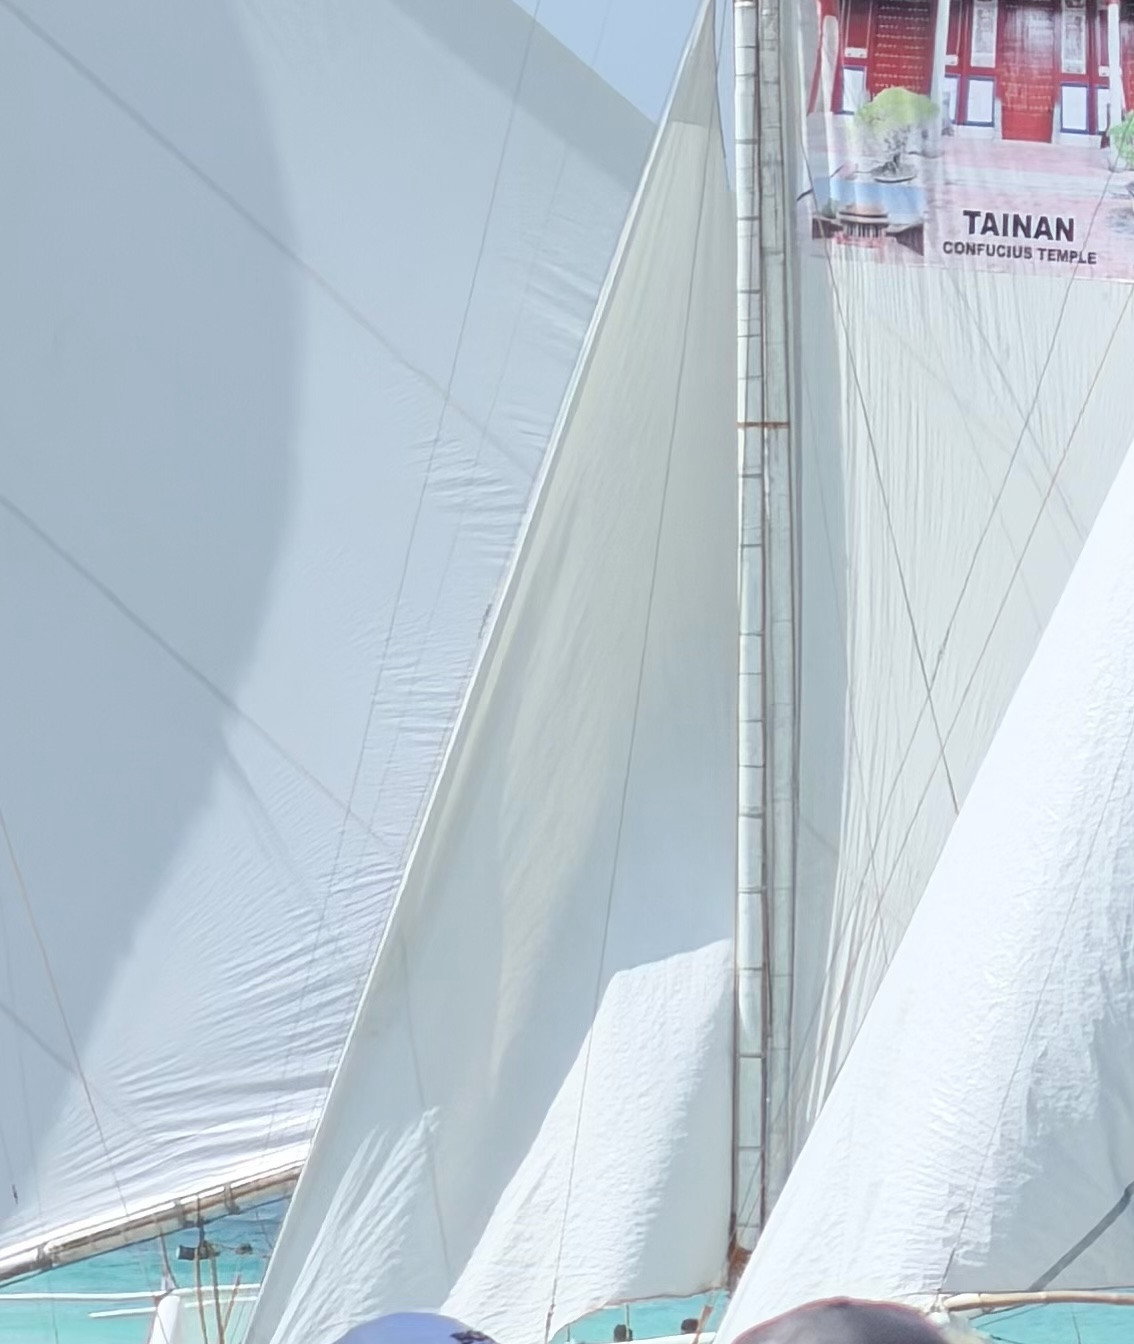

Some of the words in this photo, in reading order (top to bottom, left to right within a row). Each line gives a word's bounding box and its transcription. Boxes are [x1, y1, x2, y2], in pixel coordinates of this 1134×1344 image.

[963, 210, 1074, 242] TAINAN
[943, 241, 1032, 259] CONFUCIUS
[1037, 248, 1097, 265] TEMPLE
